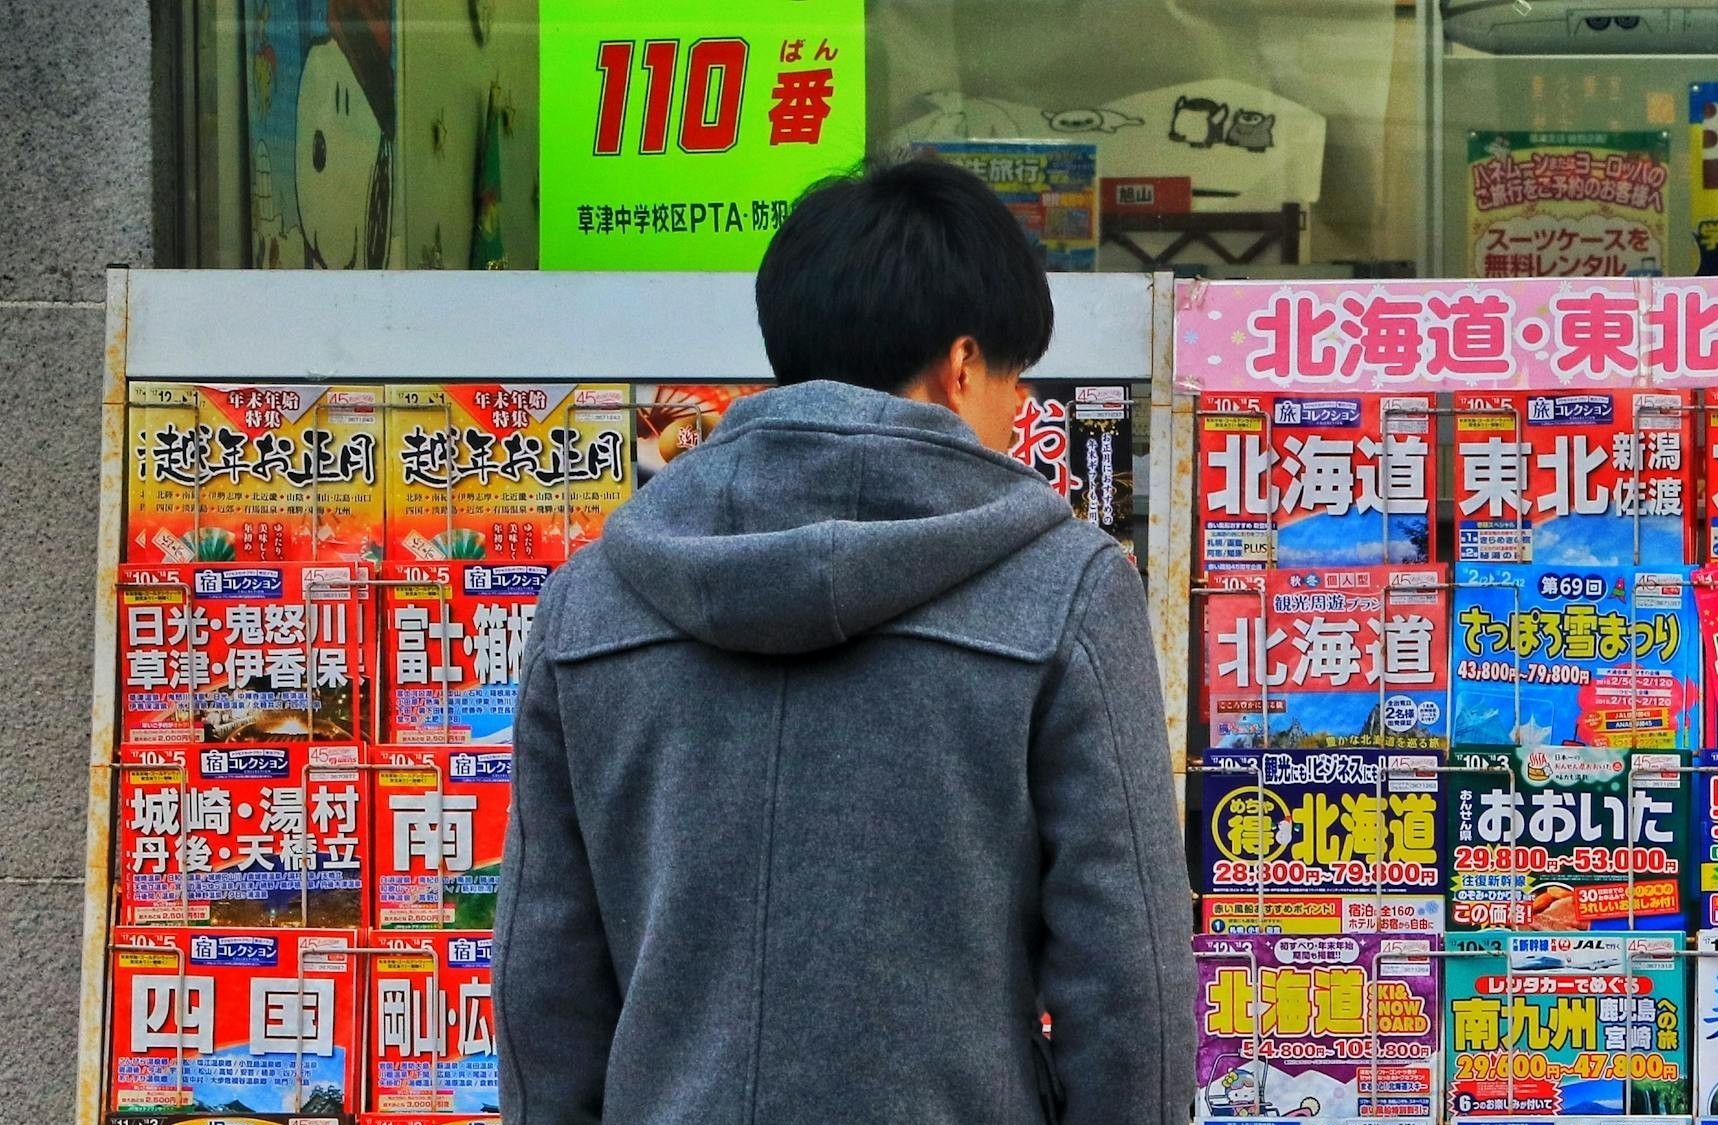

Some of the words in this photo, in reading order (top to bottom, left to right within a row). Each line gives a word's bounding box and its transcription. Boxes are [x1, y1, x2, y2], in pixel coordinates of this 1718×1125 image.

[781, 39, 838, 62] ばん
[593, 37, 749, 156] 110
[769, 69, 834, 146] 番
[1486, 228, 1650, 252] スーツケースを
[1485, 254, 1627, 277] 無料レンタル
[246, 411, 281, 428] 特集
[493, 411, 529, 428] 特集
[1206, 435, 1429, 517] 北海道
[1458, 436, 1610, 517] 東北
[1612, 477, 1682, 517] 佐渡
[1273, 591, 1381, 613] 観光周遊プラン
[1539, 576, 1604, 595] 第69回
[127, 604, 347, 646] 日光・鬼怒川
[1218, 615, 1435, 688] 北海道
[131, 786, 360, 836] 城崎・湯村
[1460, 789, 1472, 840] おんせん県
[1478, 791, 1675, 844] おおいた
[1572, 939, 1604, 951] JAL
[131, 975, 334, 1057] 四国
[1452, 997, 1595, 1051] 南九州
